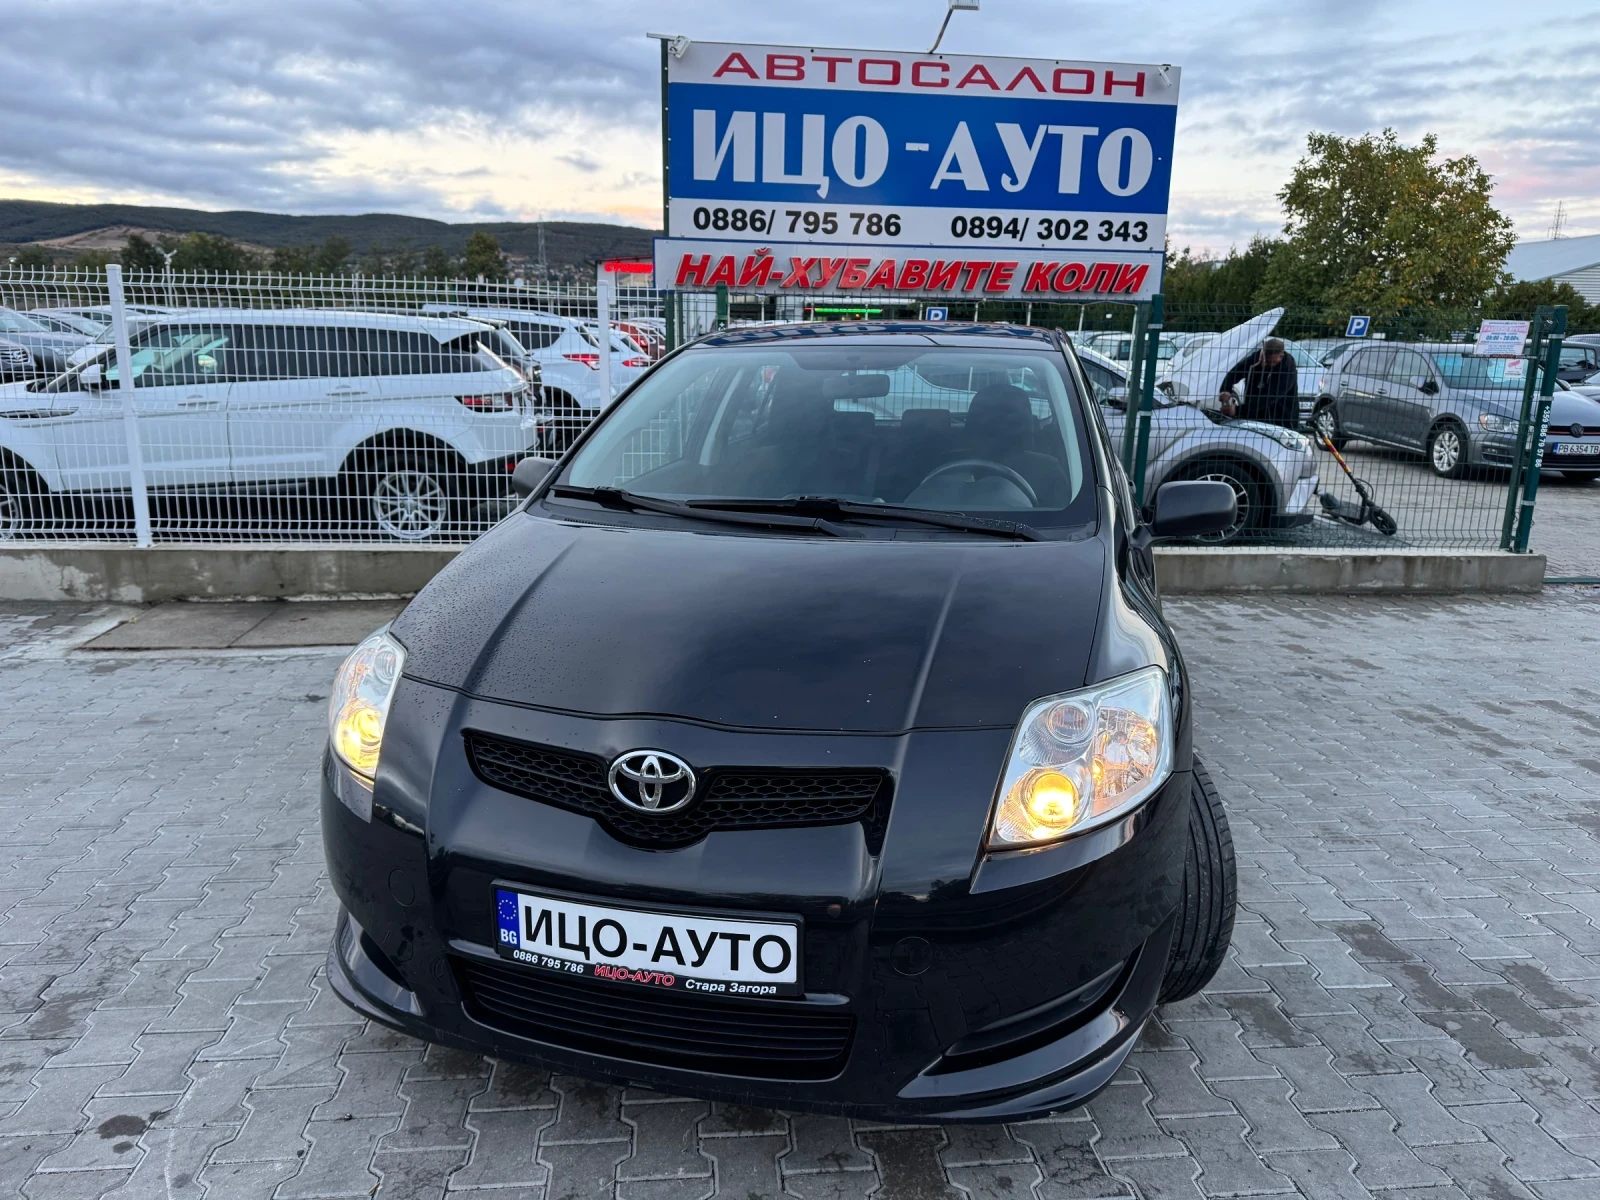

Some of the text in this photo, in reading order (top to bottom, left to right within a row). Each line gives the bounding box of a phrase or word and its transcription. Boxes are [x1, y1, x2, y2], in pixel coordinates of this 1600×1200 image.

[712, 52, 1146, 97] АВТОСАЛОН
[785, 210, 839, 235] 795
[850, 212, 902, 236] 786
[1037, 218, 1089, 241] 302
[1097, 220, 1149, 242] 343
[674, 247, 1151, 293] НАЙ-ХУБАВИТЕ КОЛИ
[500, 928, 518, 945] BG
[524, 906, 792, 975] ИЦО-АУТО
[513, 949, 777, 995] 0886 795 786 ИЦО-АУТО Стара Загора
